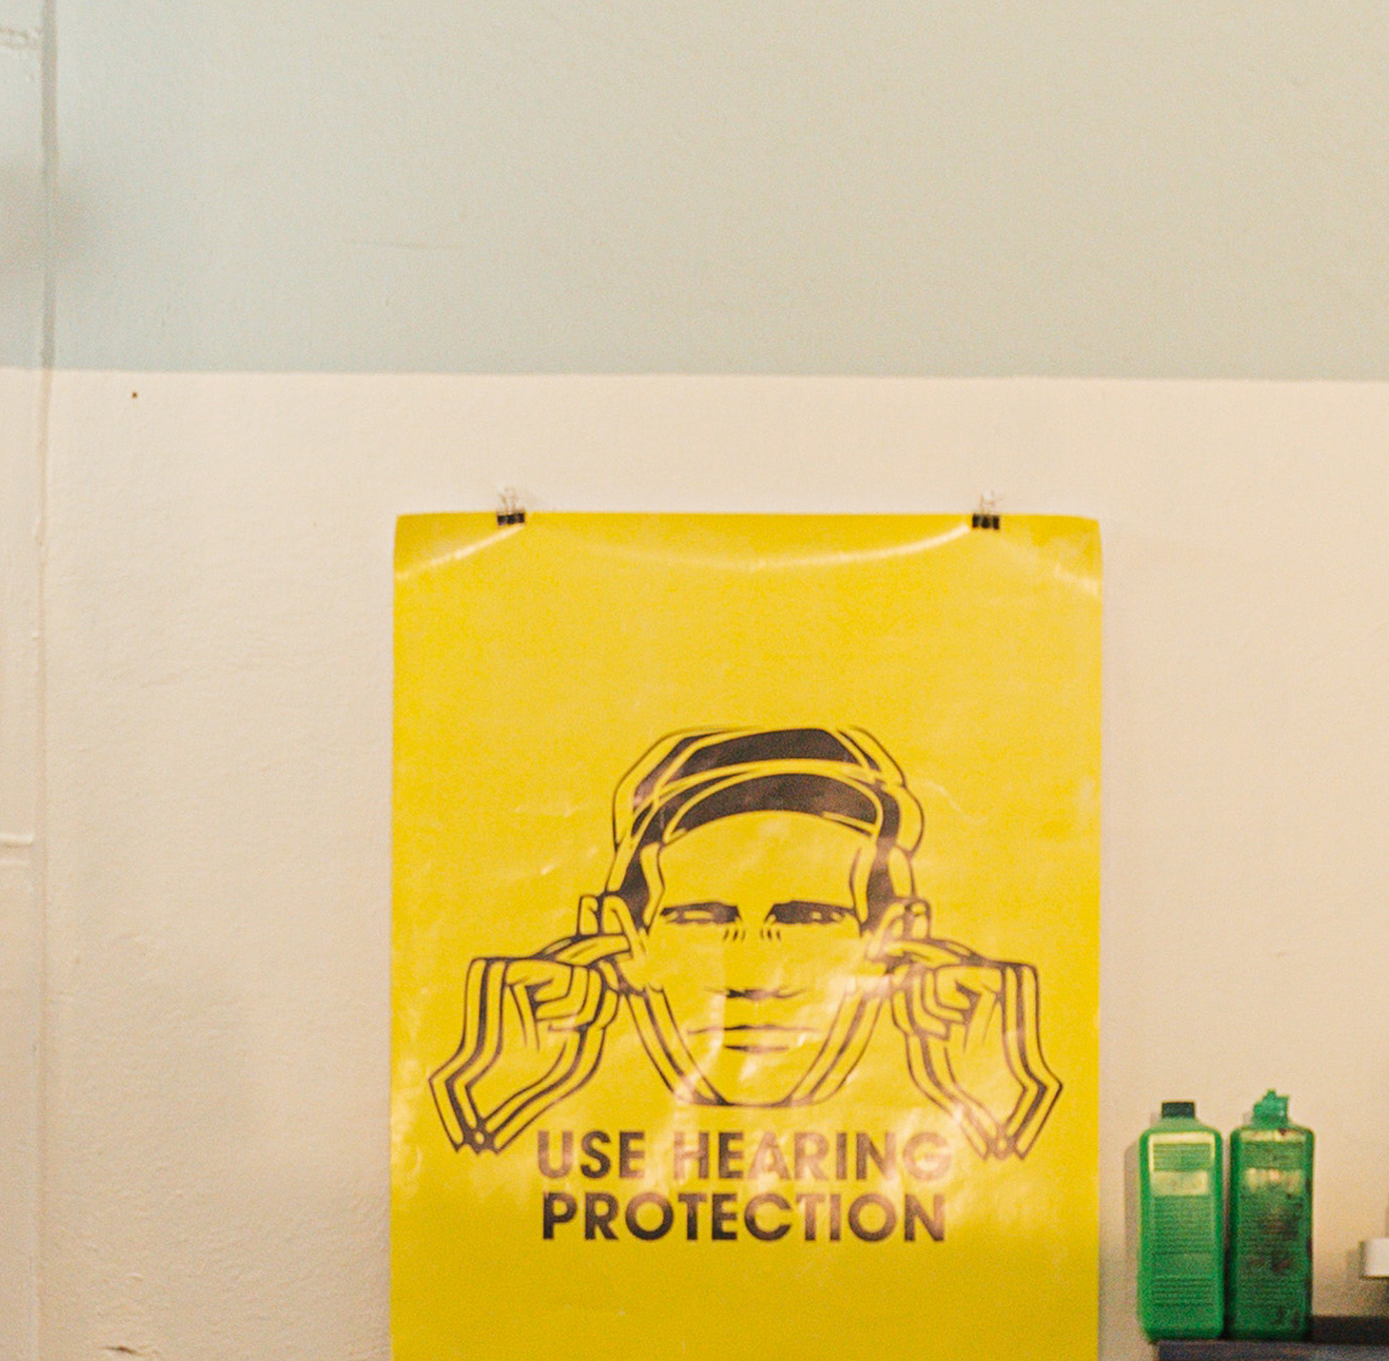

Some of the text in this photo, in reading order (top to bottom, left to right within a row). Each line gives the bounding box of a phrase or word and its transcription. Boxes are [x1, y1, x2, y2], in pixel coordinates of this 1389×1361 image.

[537, 1130, 954, 1181] USE HEARING
[543, 1192, 947, 1242] PROTECTION
